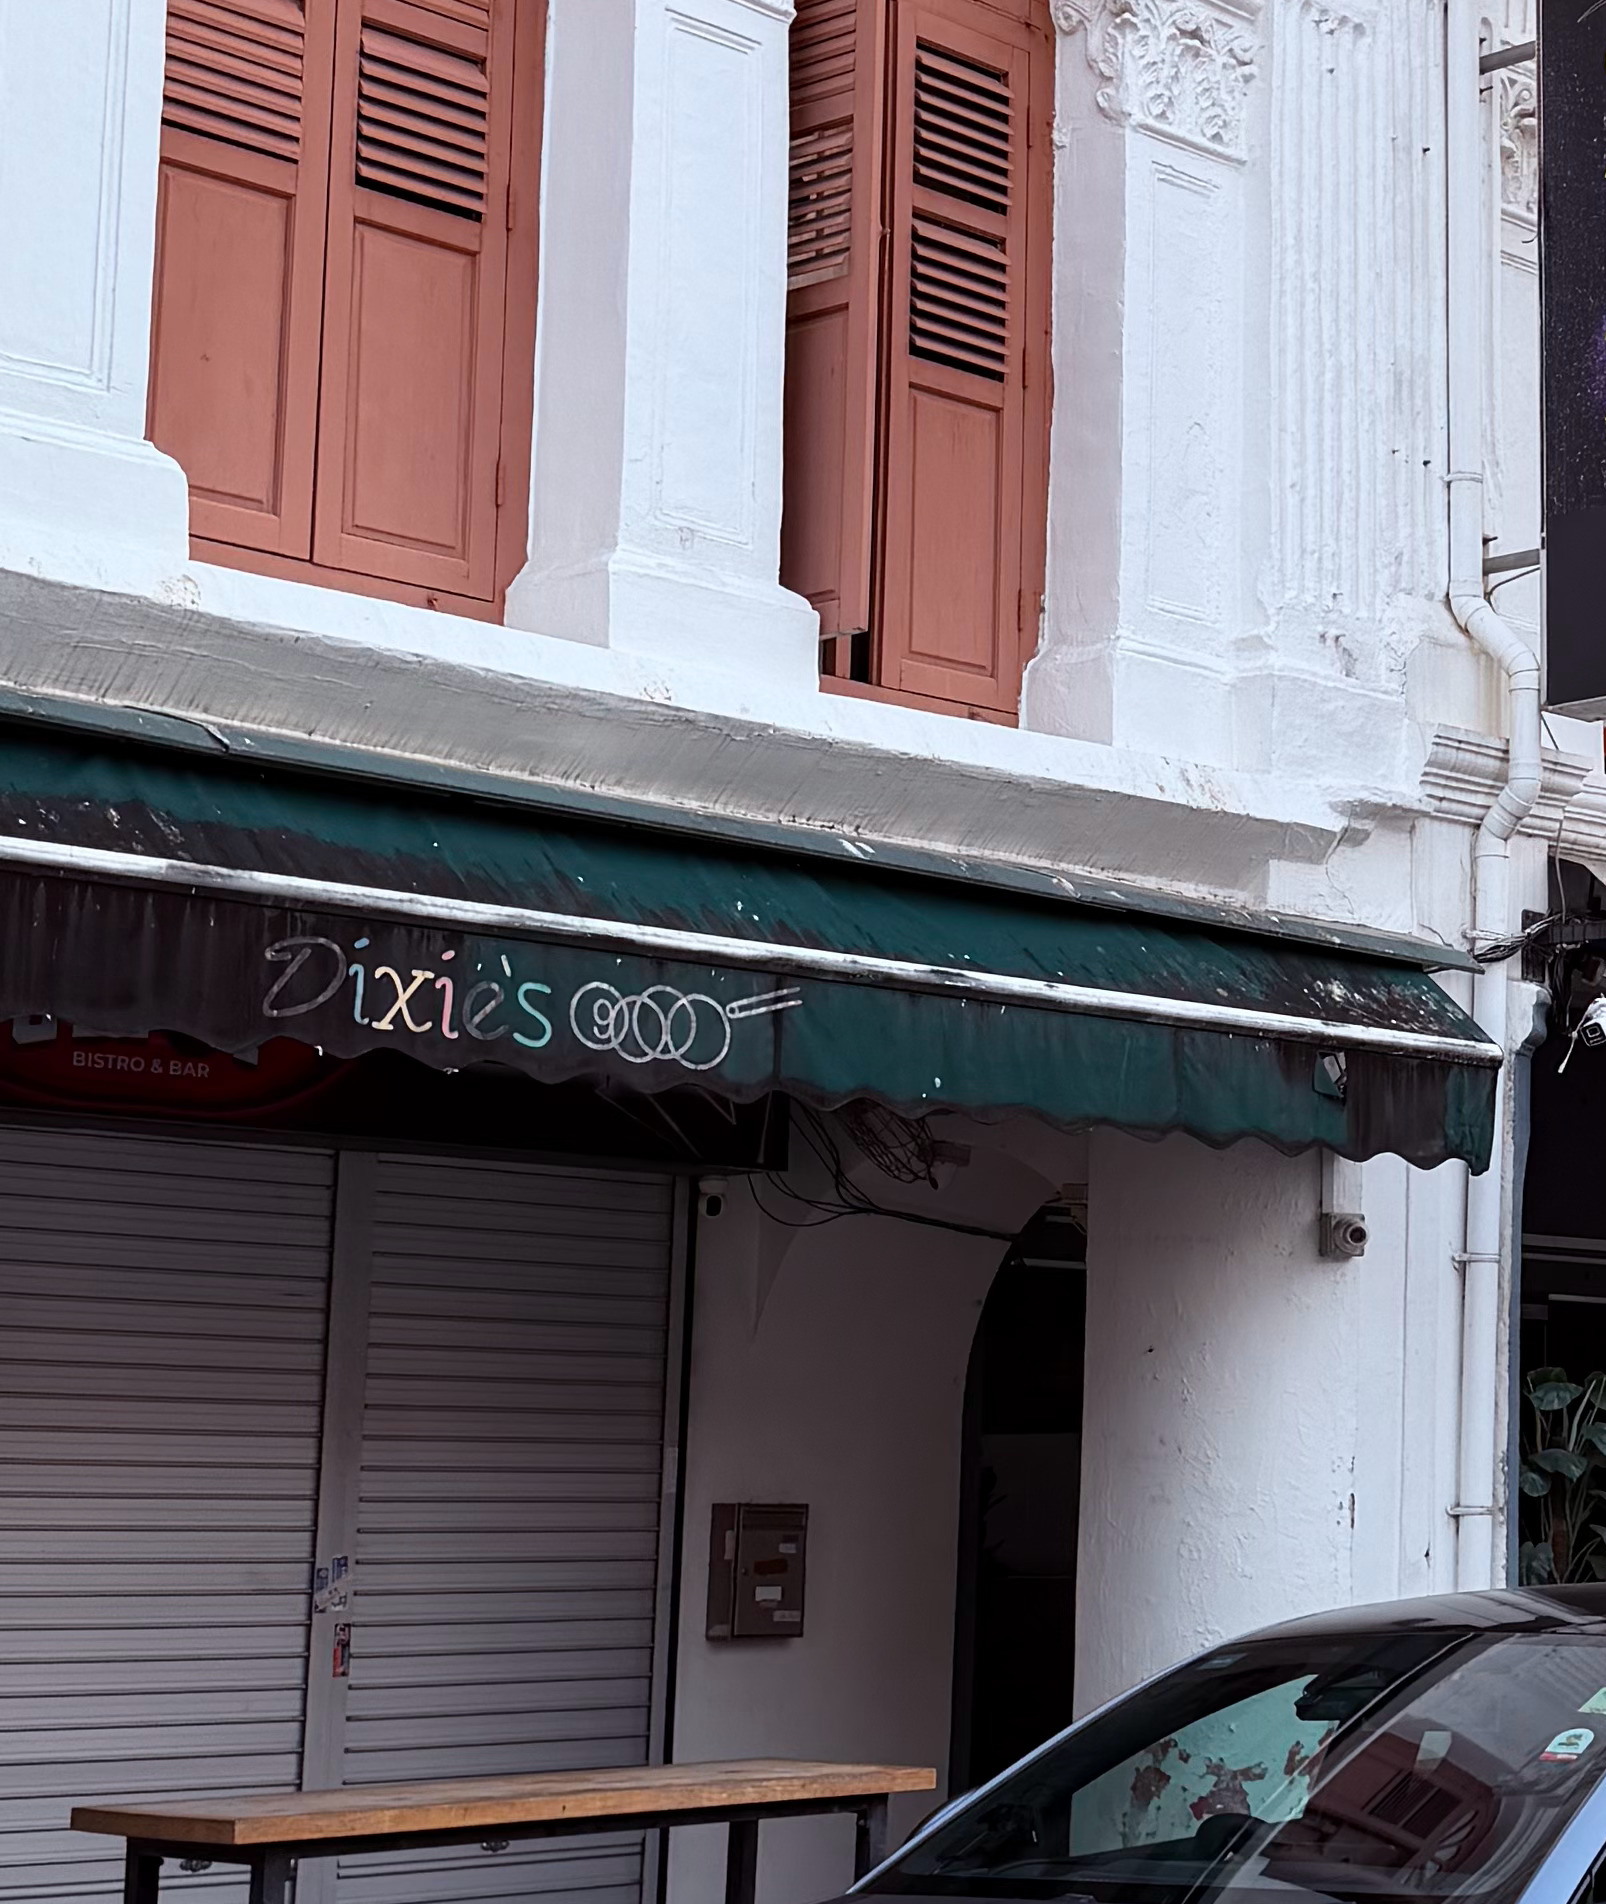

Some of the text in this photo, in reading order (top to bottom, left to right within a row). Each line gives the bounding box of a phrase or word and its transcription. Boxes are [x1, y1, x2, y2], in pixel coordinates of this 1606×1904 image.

[262, 934, 553, 1049] Dixie's
[72, 1050, 210, 1078] BISTRO & BAR
